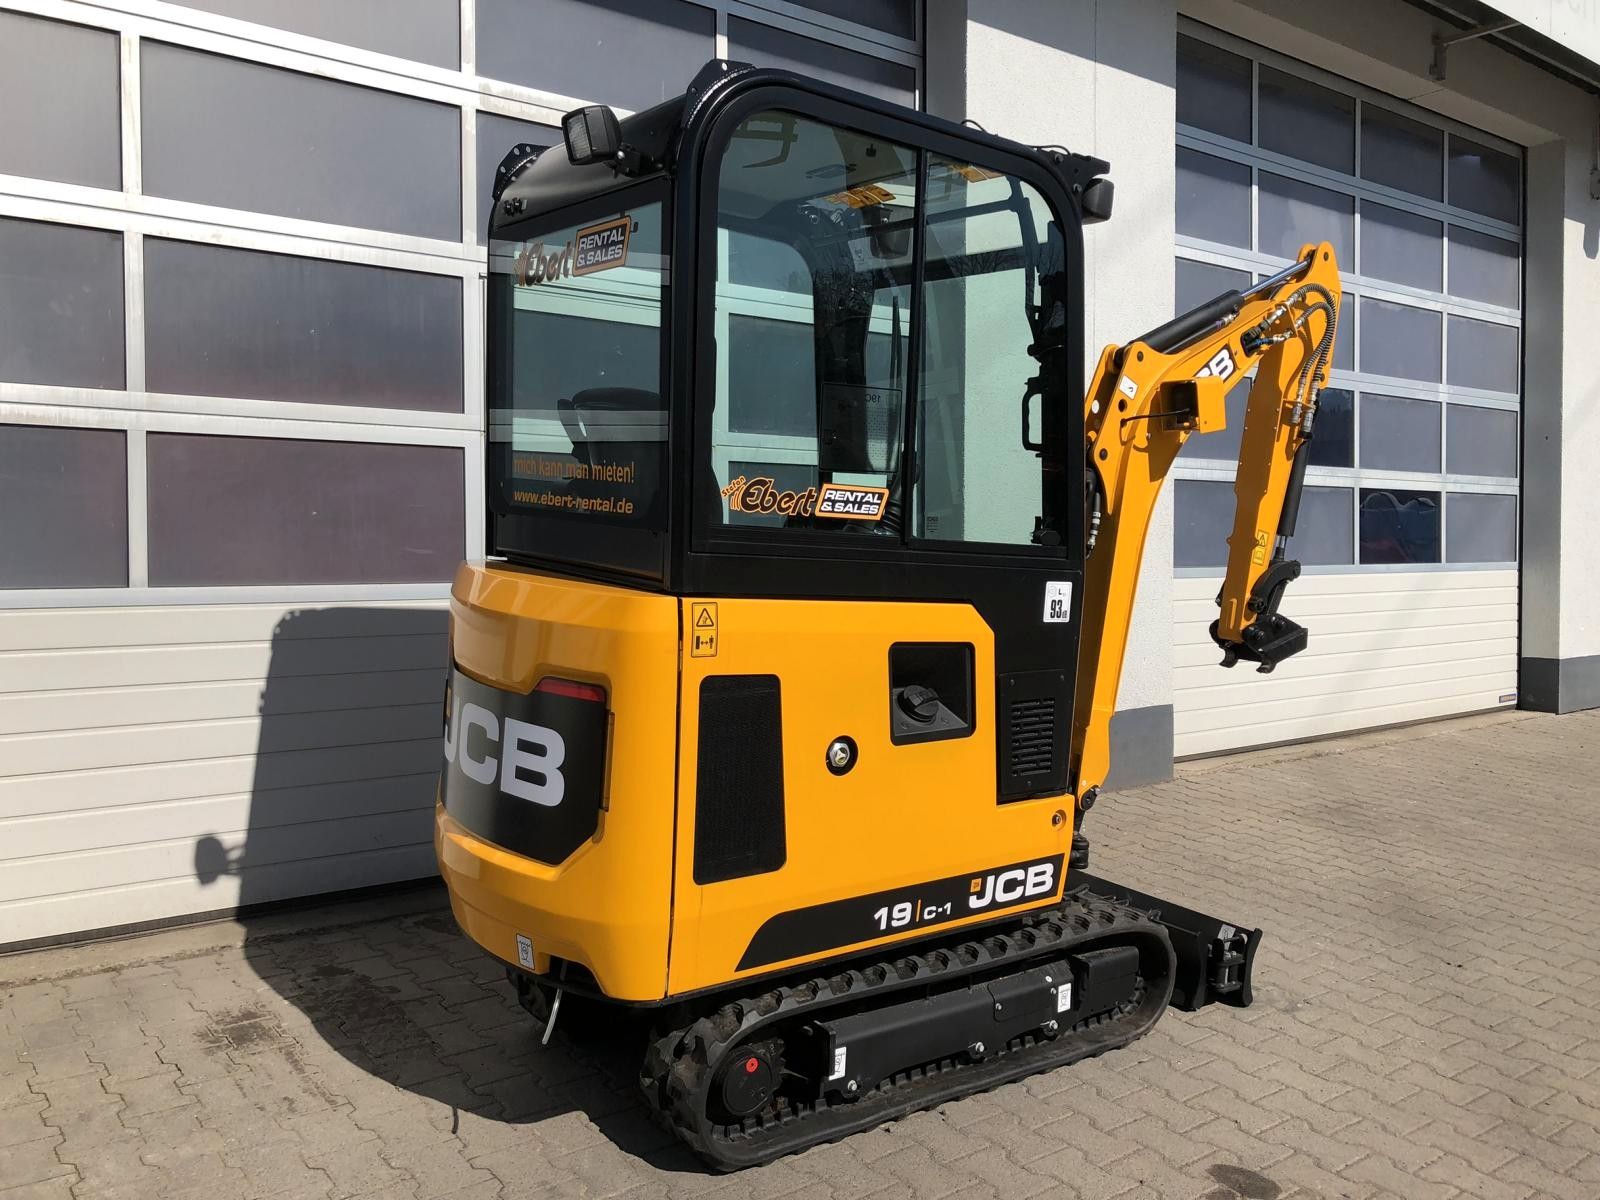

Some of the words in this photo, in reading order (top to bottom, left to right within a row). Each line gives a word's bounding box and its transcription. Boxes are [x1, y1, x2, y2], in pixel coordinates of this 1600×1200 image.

[578, 227, 625, 251] RENTAL
[525, 240, 573, 287] Ebert
[576, 254, 586, 267] &
[586, 244, 624, 265] SALES
[513, 456, 538, 475] mich
[539, 458, 563, 478] kann
[567, 462, 589, 480] man
[592, 460, 635, 483] mieten!
[513, 489, 634, 514] www.ebert-rental.de
[741, 477, 817, 517] Ebert
[820, 502, 832, 512] &
[833, 502, 880, 515] SALES
[824, 490, 882, 504] RENTAL
[1050, 599, 1063, 618] 93
[445, 697, 565, 806] JCB
[968, 862, 1054, 909] JCB
[873, 902, 913, 931] 19
[923, 902, 952, 921] C-1
